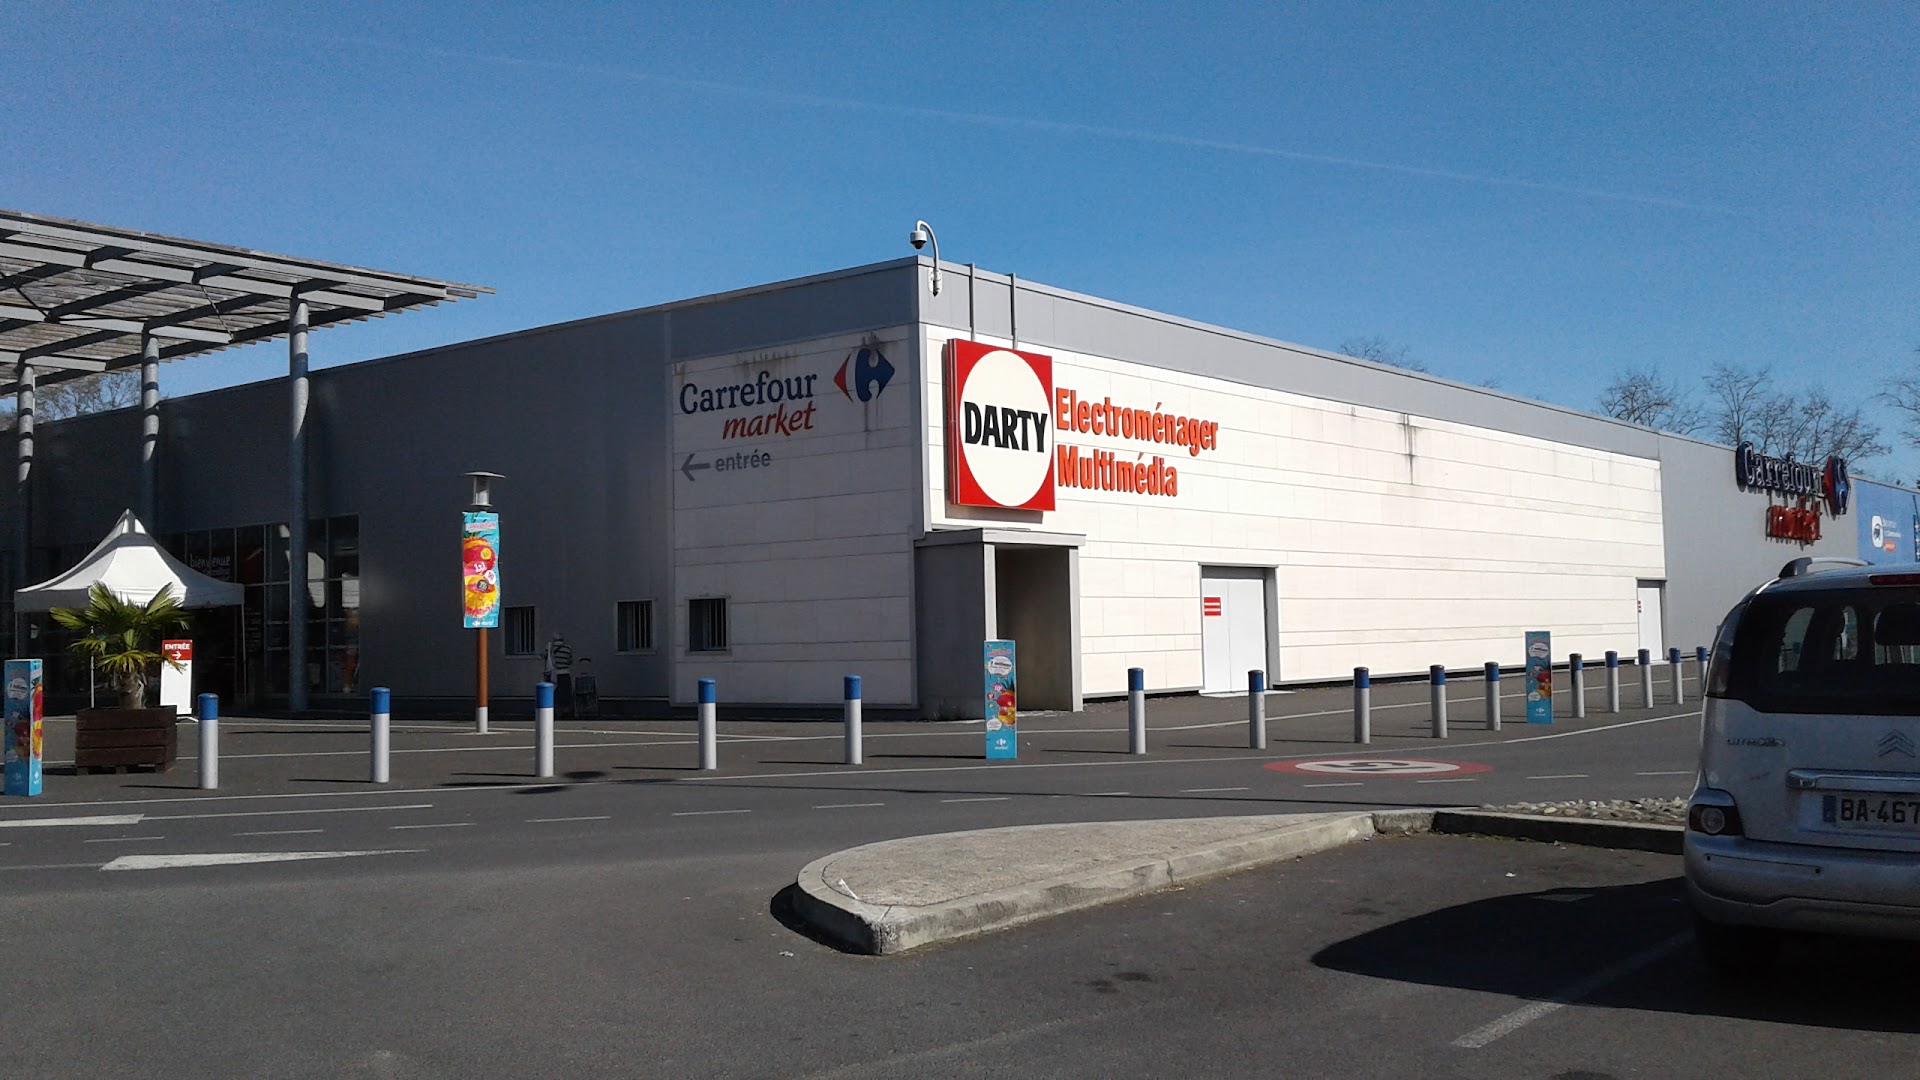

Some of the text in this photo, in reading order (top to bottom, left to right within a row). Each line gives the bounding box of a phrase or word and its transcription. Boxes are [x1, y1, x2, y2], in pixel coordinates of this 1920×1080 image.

[680, 370, 818, 415] Carrefour
[721, 402, 817, 441] market
[964, 401, 1049, 454] DARTY
[1056, 387, 1219, 457] Electroménager
[714, 449, 772, 473] entrée
[1057, 445, 1178, 498] Multimédia
[1737, 441, 1824, 499] Carrefour
[164, 642, 191, 650] ENTRÉE
[1840, 799, 1920, 824] BA-467
